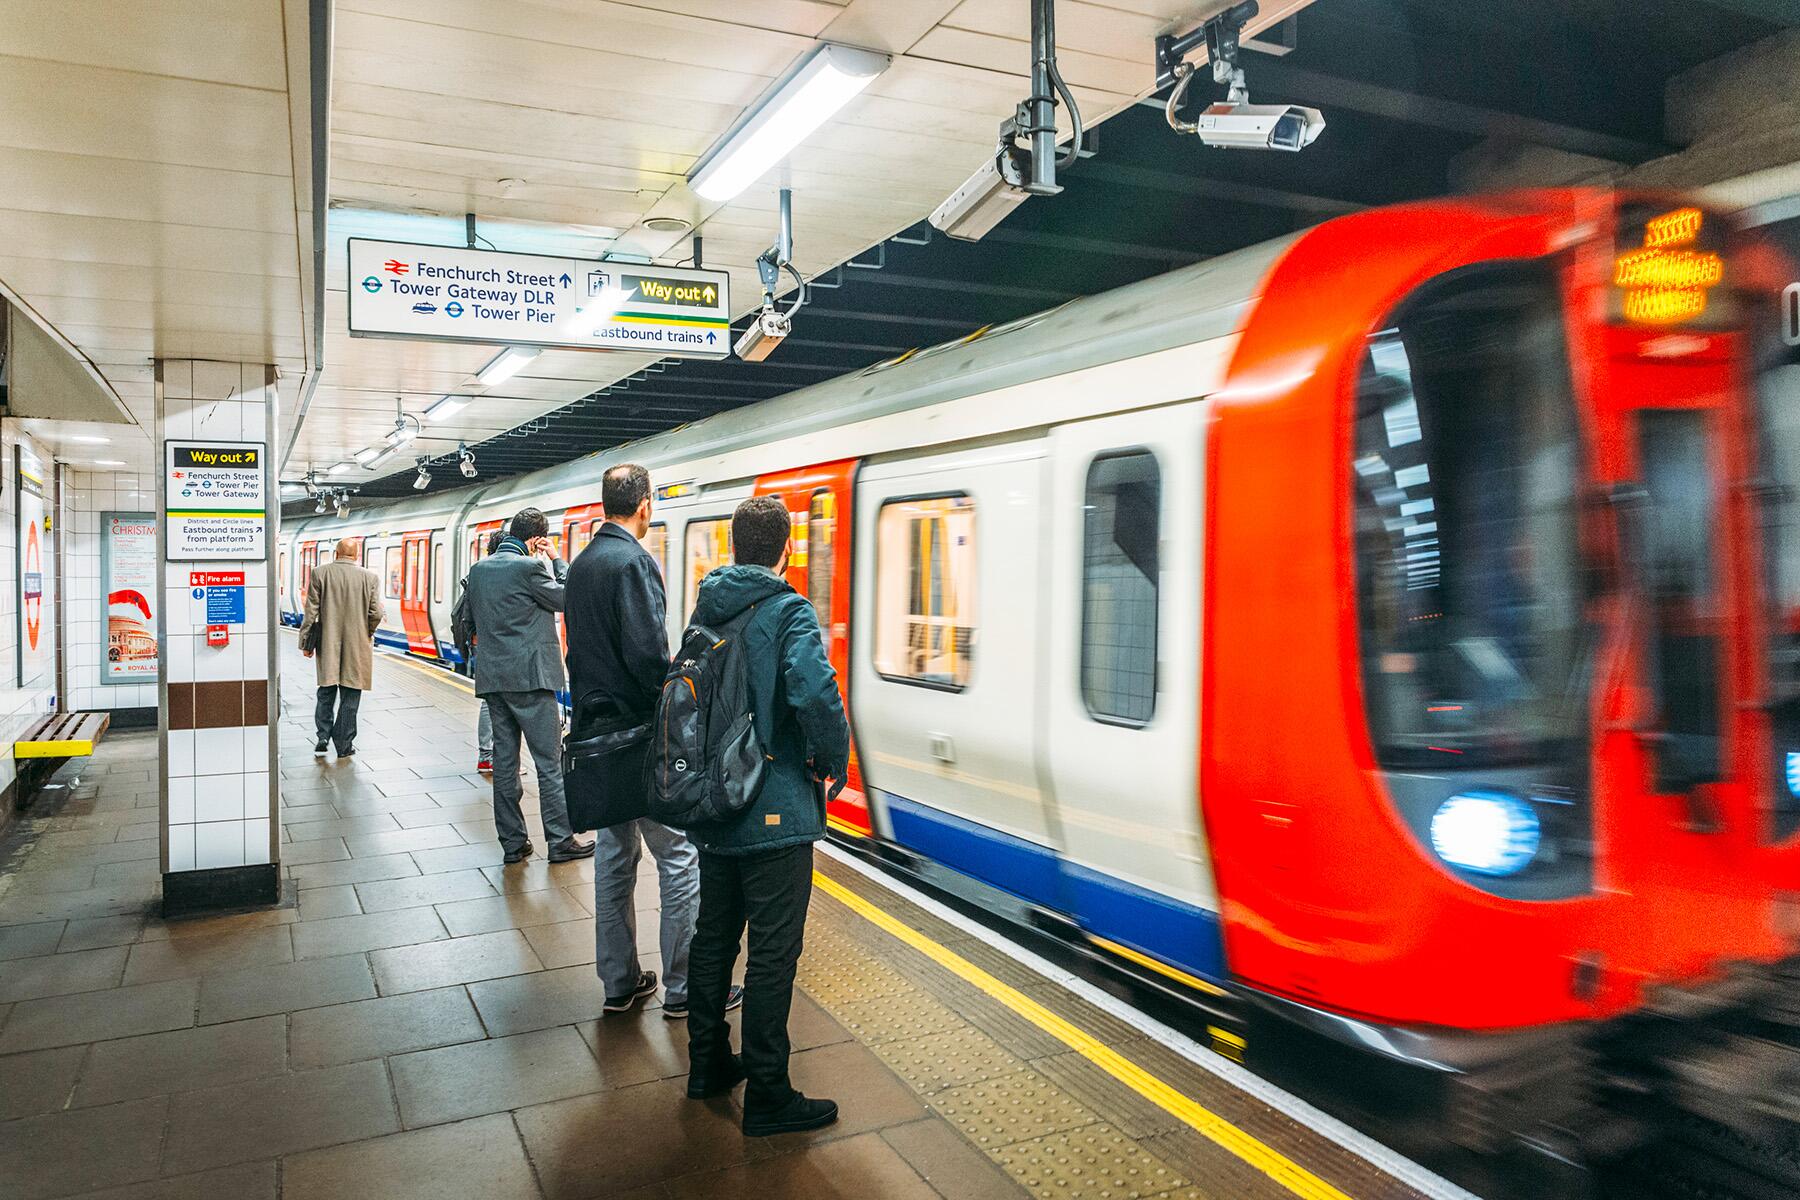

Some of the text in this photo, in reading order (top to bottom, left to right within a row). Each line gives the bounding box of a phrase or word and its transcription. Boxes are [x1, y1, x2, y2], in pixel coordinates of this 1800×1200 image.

[417, 262, 555, 287] Fenchurch Street
[390, 279, 555, 306] Tower Gateway DLR
[640, 280, 701, 301] Way out
[472, 304, 556, 323] Tower Pier
[667, 331, 703, 344] trains
[190, 451, 242, 465] Way out
[188, 472, 230, 480] Fenchurch
[216, 481, 240, 489] Tower
[223, 490, 259, 499] Gateway
[112, 525, 156, 535] CHRISTM
[183, 526, 254, 534] Eastbound trains
[187, 535, 254, 544] from platform 3
